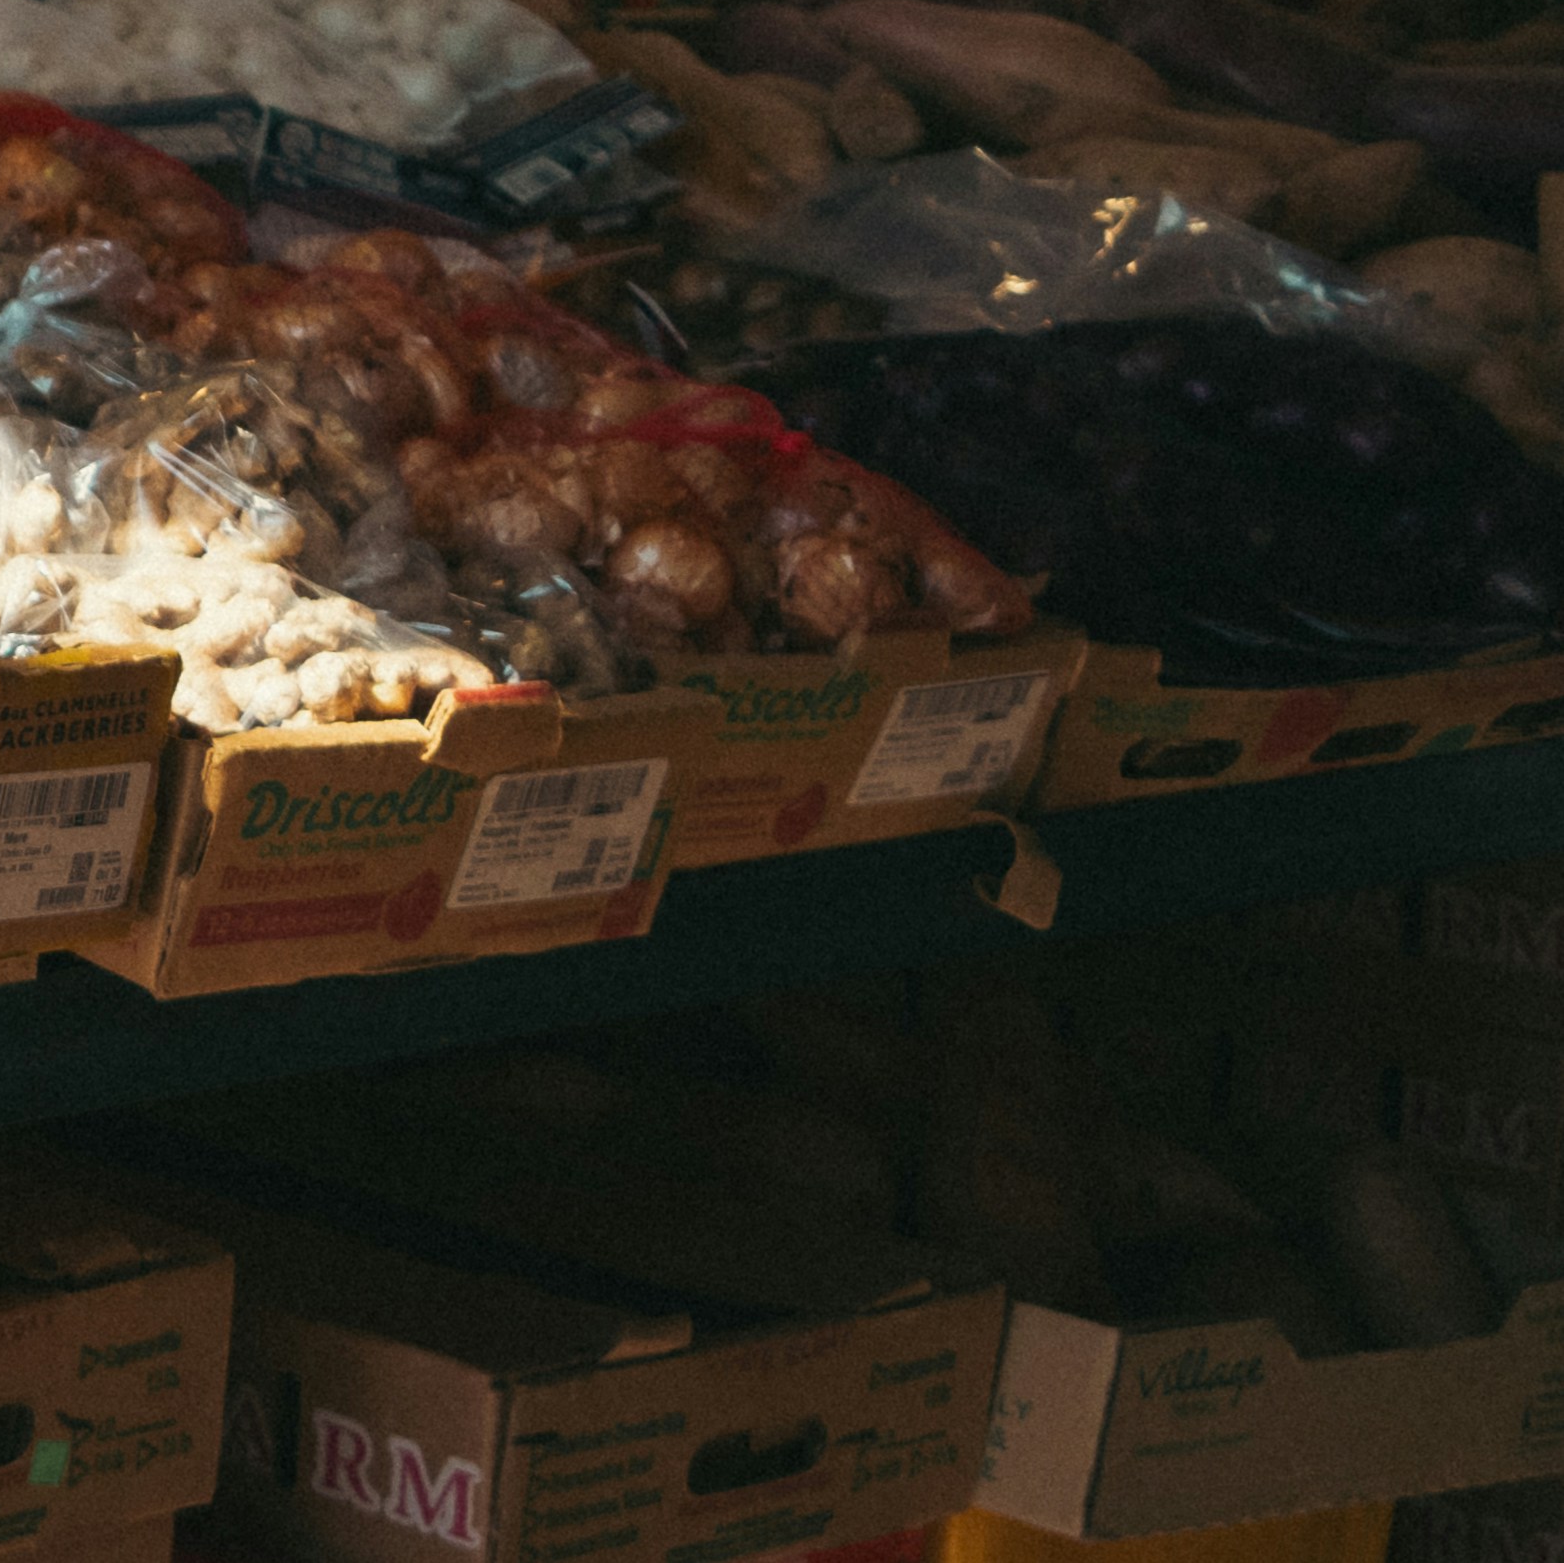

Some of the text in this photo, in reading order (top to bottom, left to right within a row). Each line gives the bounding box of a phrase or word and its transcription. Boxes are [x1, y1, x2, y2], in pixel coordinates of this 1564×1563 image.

[33, 685, 151, 718] CLAMSHELLS
[221, 860, 363, 892] Raspberries
[1134, 1346, 1266, 1406] Village
